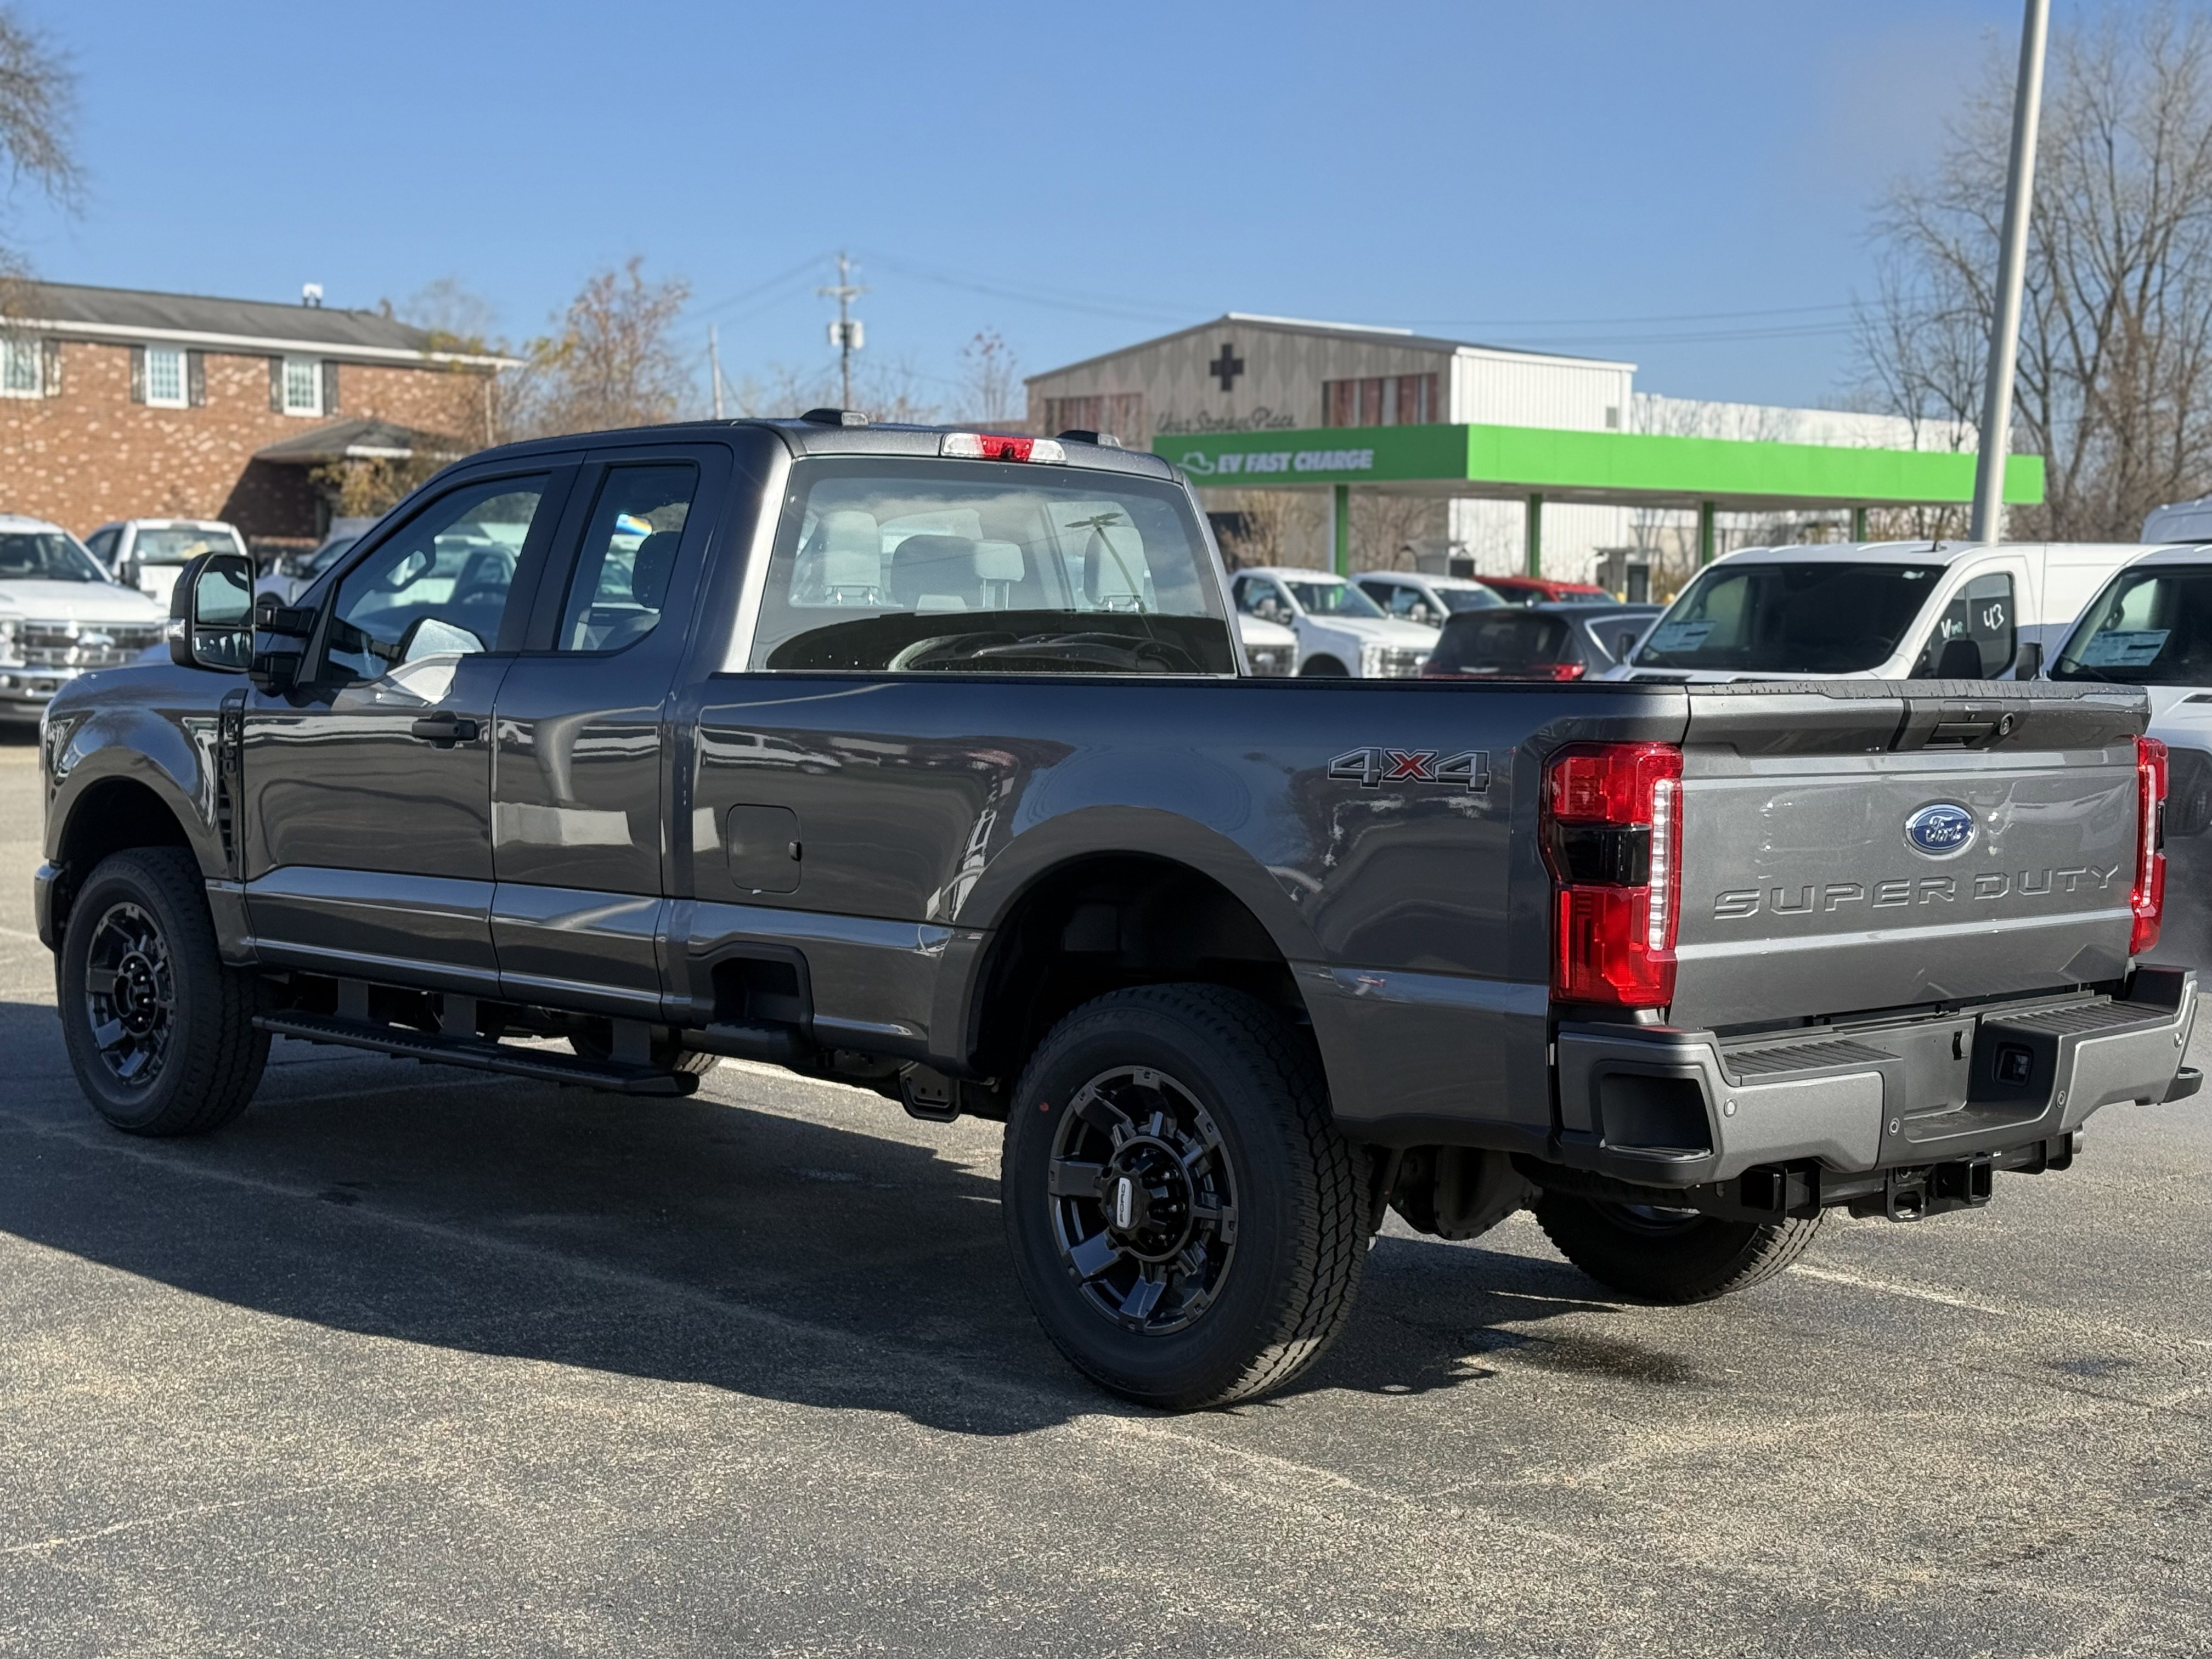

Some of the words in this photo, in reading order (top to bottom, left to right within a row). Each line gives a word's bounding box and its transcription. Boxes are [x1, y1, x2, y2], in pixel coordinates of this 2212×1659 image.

[1217, 453, 1243, 474] EV
[1244, 452, 1292, 473] FAST
[1293, 449, 1374, 472] CHARGE
[1983, 603, 2005, 630] 43
[1926, 815, 1962, 842] Ford
[1714, 877, 1956, 920] SUPER
[1974, 863, 2119, 900] DUTY
